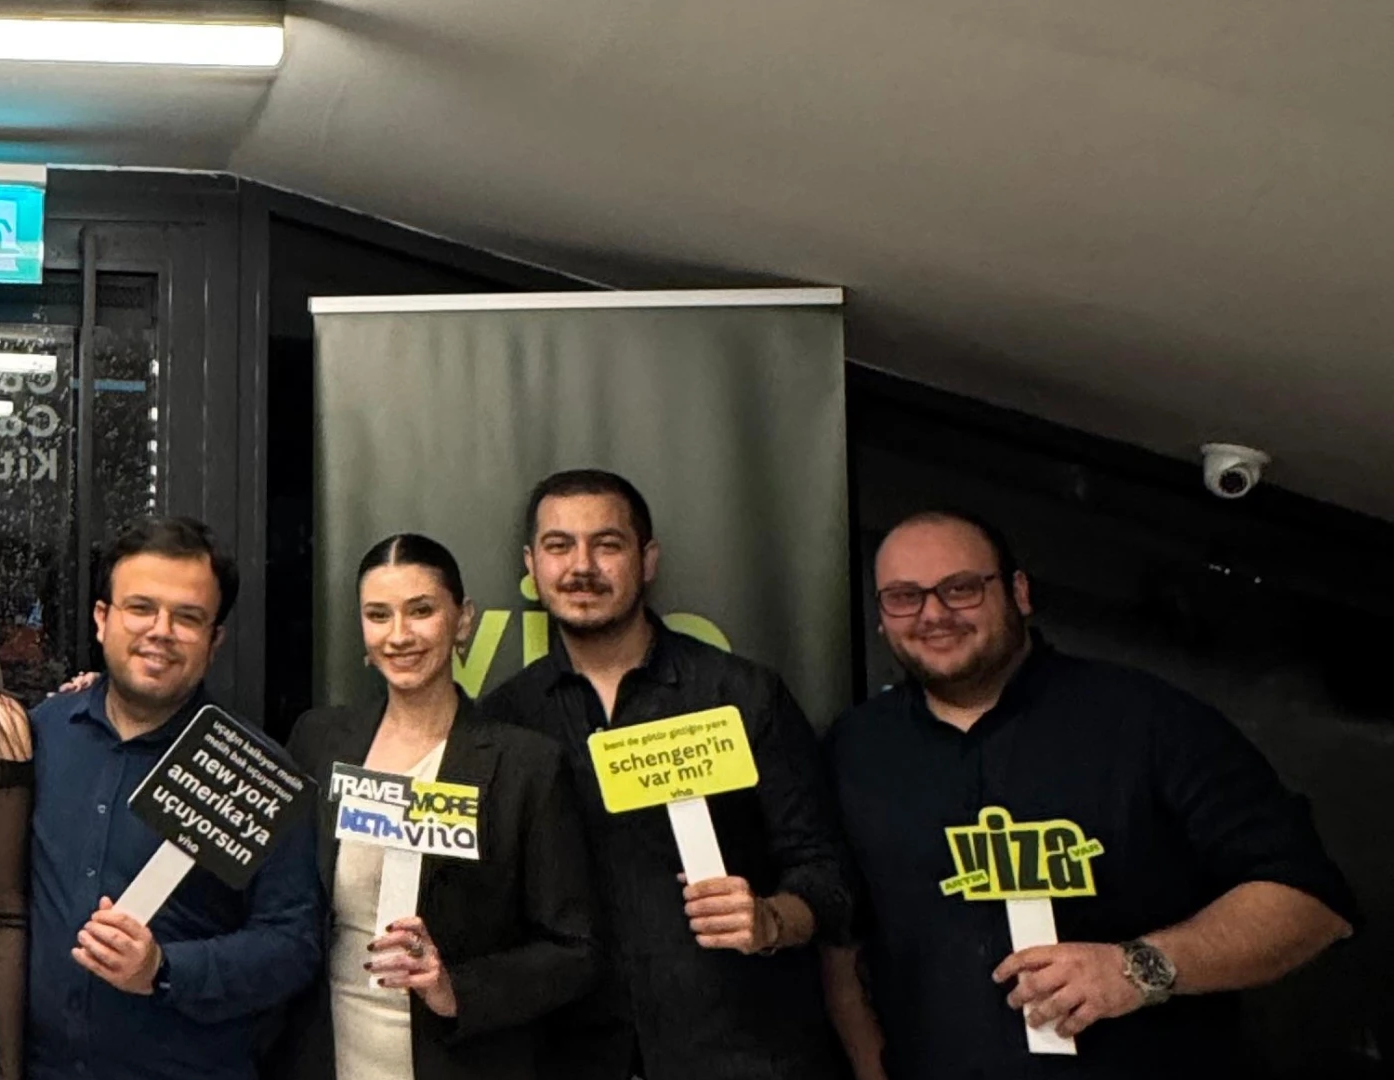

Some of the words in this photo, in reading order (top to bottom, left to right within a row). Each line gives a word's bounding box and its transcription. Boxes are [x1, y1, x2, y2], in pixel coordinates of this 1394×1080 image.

[609, 736, 734, 774] schengen'in
[638, 770, 671, 788] var
[678, 759, 714, 781] mı?
[192, 749, 236, 786] new
[230, 779, 281, 819] york
[332, 773, 410, 806] TRAVEL
[409, 791, 478, 816] MORE
[152, 785, 253, 865] uçuyorsun
[954, 814, 1087, 892] viza
